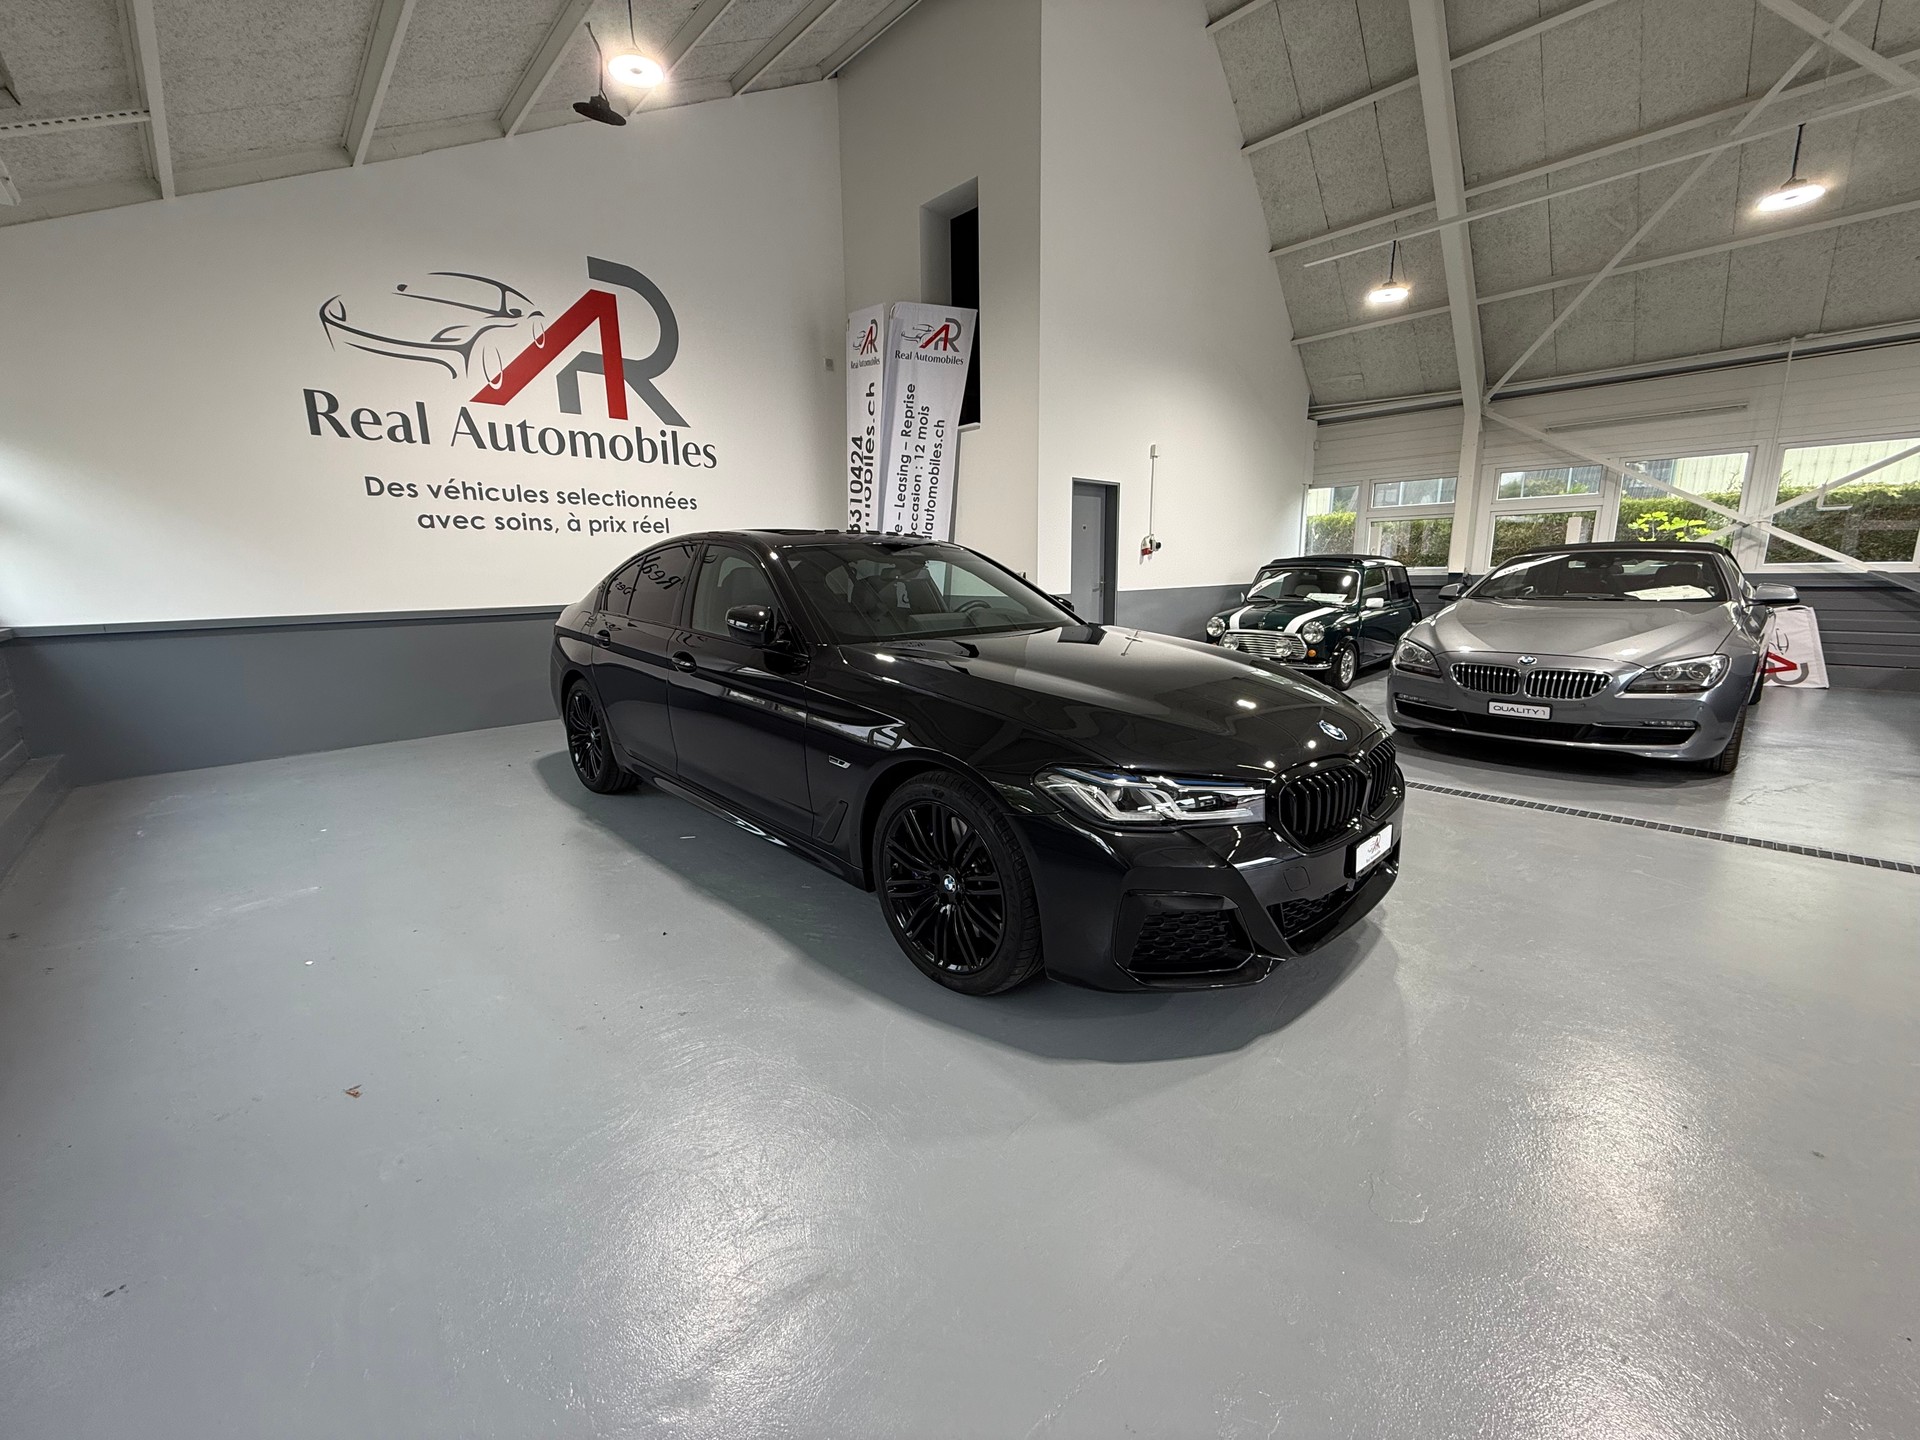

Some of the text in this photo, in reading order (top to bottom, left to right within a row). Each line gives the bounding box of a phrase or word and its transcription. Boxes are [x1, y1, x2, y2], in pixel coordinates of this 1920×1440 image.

[894, 349, 964, 366] Real Automobiles
[900, 383, 916, 437] Reprise
[917, 405, 930, 440] mois
[302, 387, 718, 470] Real Automobiles
[914, 444, 926, 460] 12
[364, 475, 698, 511] Des véhicules selectionnées
[894, 454, 912, 508] Leasing
[417, 511, 671, 537] avec soins, à prix réel
[1493, 705, 1540, 715] QUALITY
